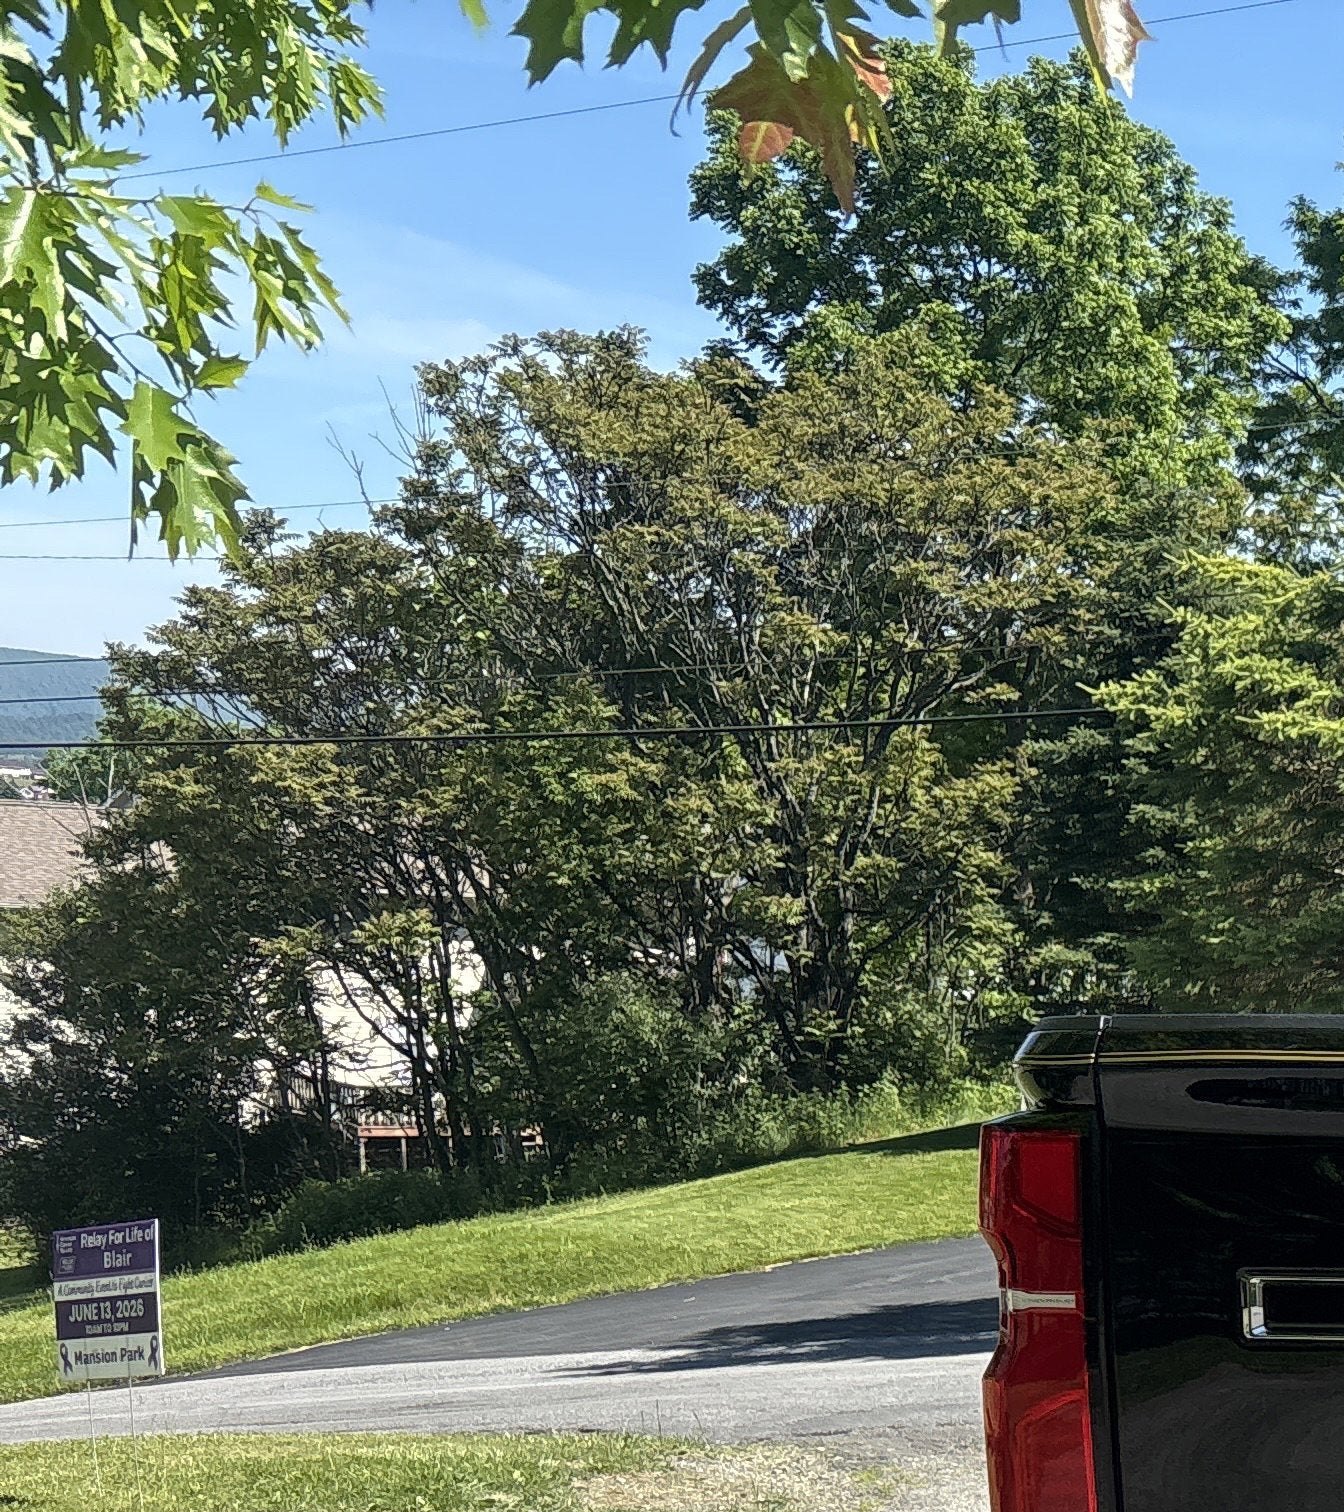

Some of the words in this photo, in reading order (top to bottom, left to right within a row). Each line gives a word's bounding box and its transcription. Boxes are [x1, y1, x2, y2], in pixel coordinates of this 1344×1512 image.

[80, 1231, 107, 1250] Relay
[108, 1229, 124, 1245] For
[125, 1225, 143, 1243] Life
[144, 1223, 155, 1241] of
[103, 1248, 133, 1269] Blair
[68, 1303, 99, 1322] JUNE
[100, 1301, 115, 1322] 13,
[116, 1298, 145, 1318] 2026
[74, 1348, 118, 1366] Mansion
[120, 1345, 145, 1362] Park
